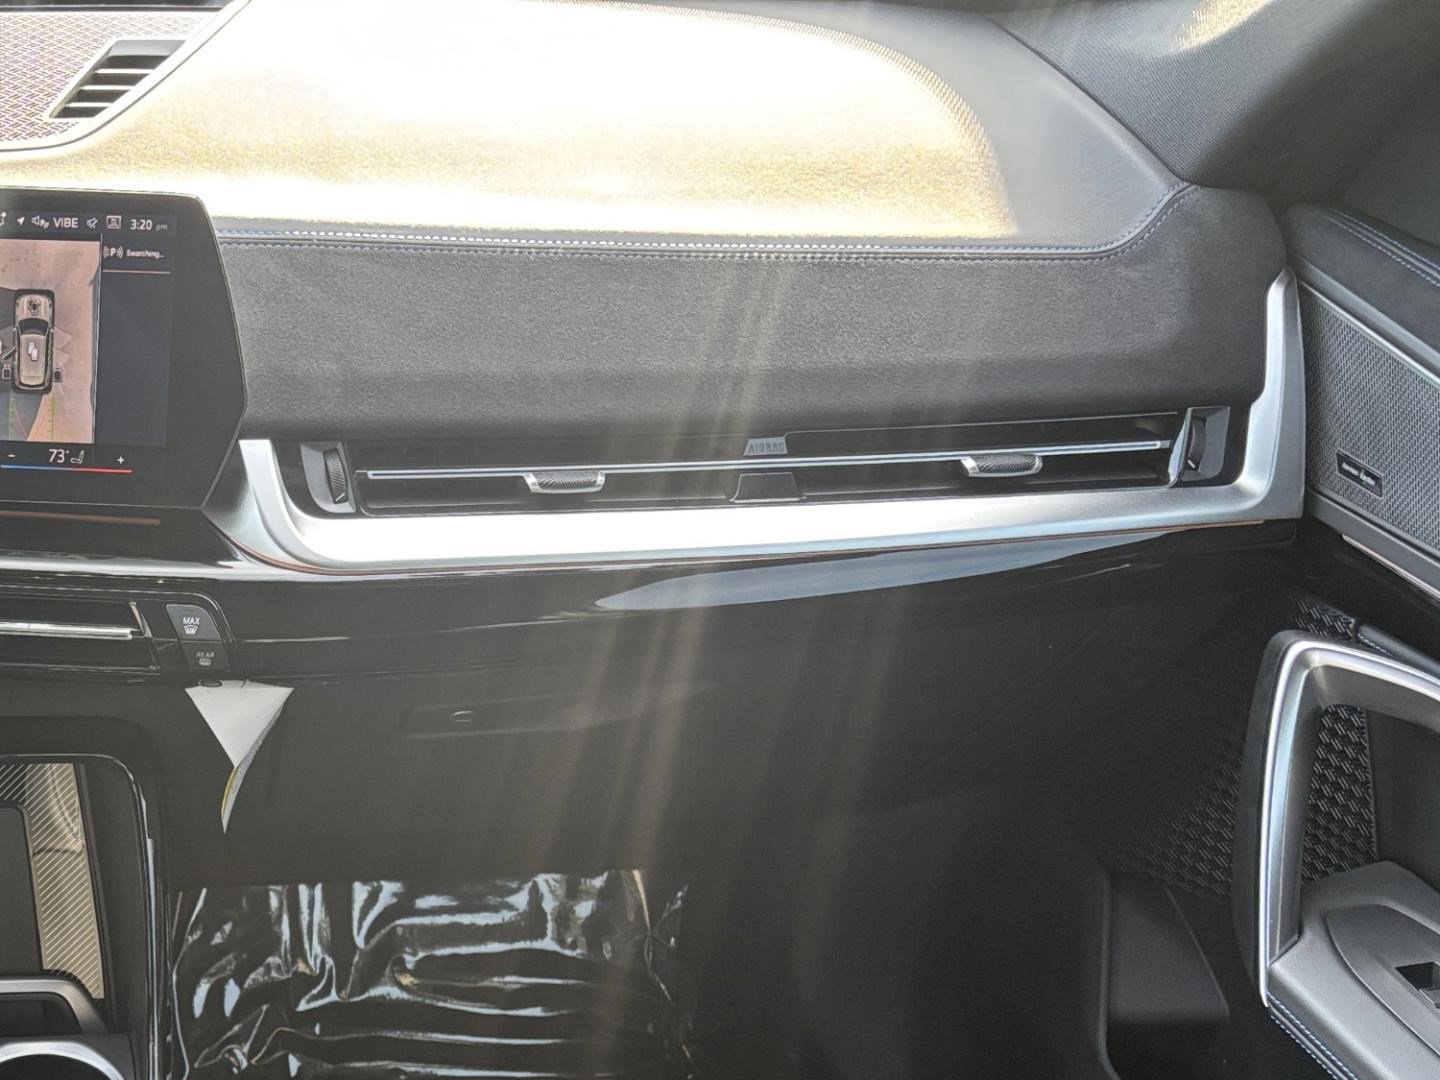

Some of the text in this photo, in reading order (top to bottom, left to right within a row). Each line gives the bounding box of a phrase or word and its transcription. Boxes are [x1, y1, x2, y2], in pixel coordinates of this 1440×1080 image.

[52, 217, 79, 229] VIBE
[129, 218, 153, 231] 3:20
[182, 616, 201, 625] MAX
